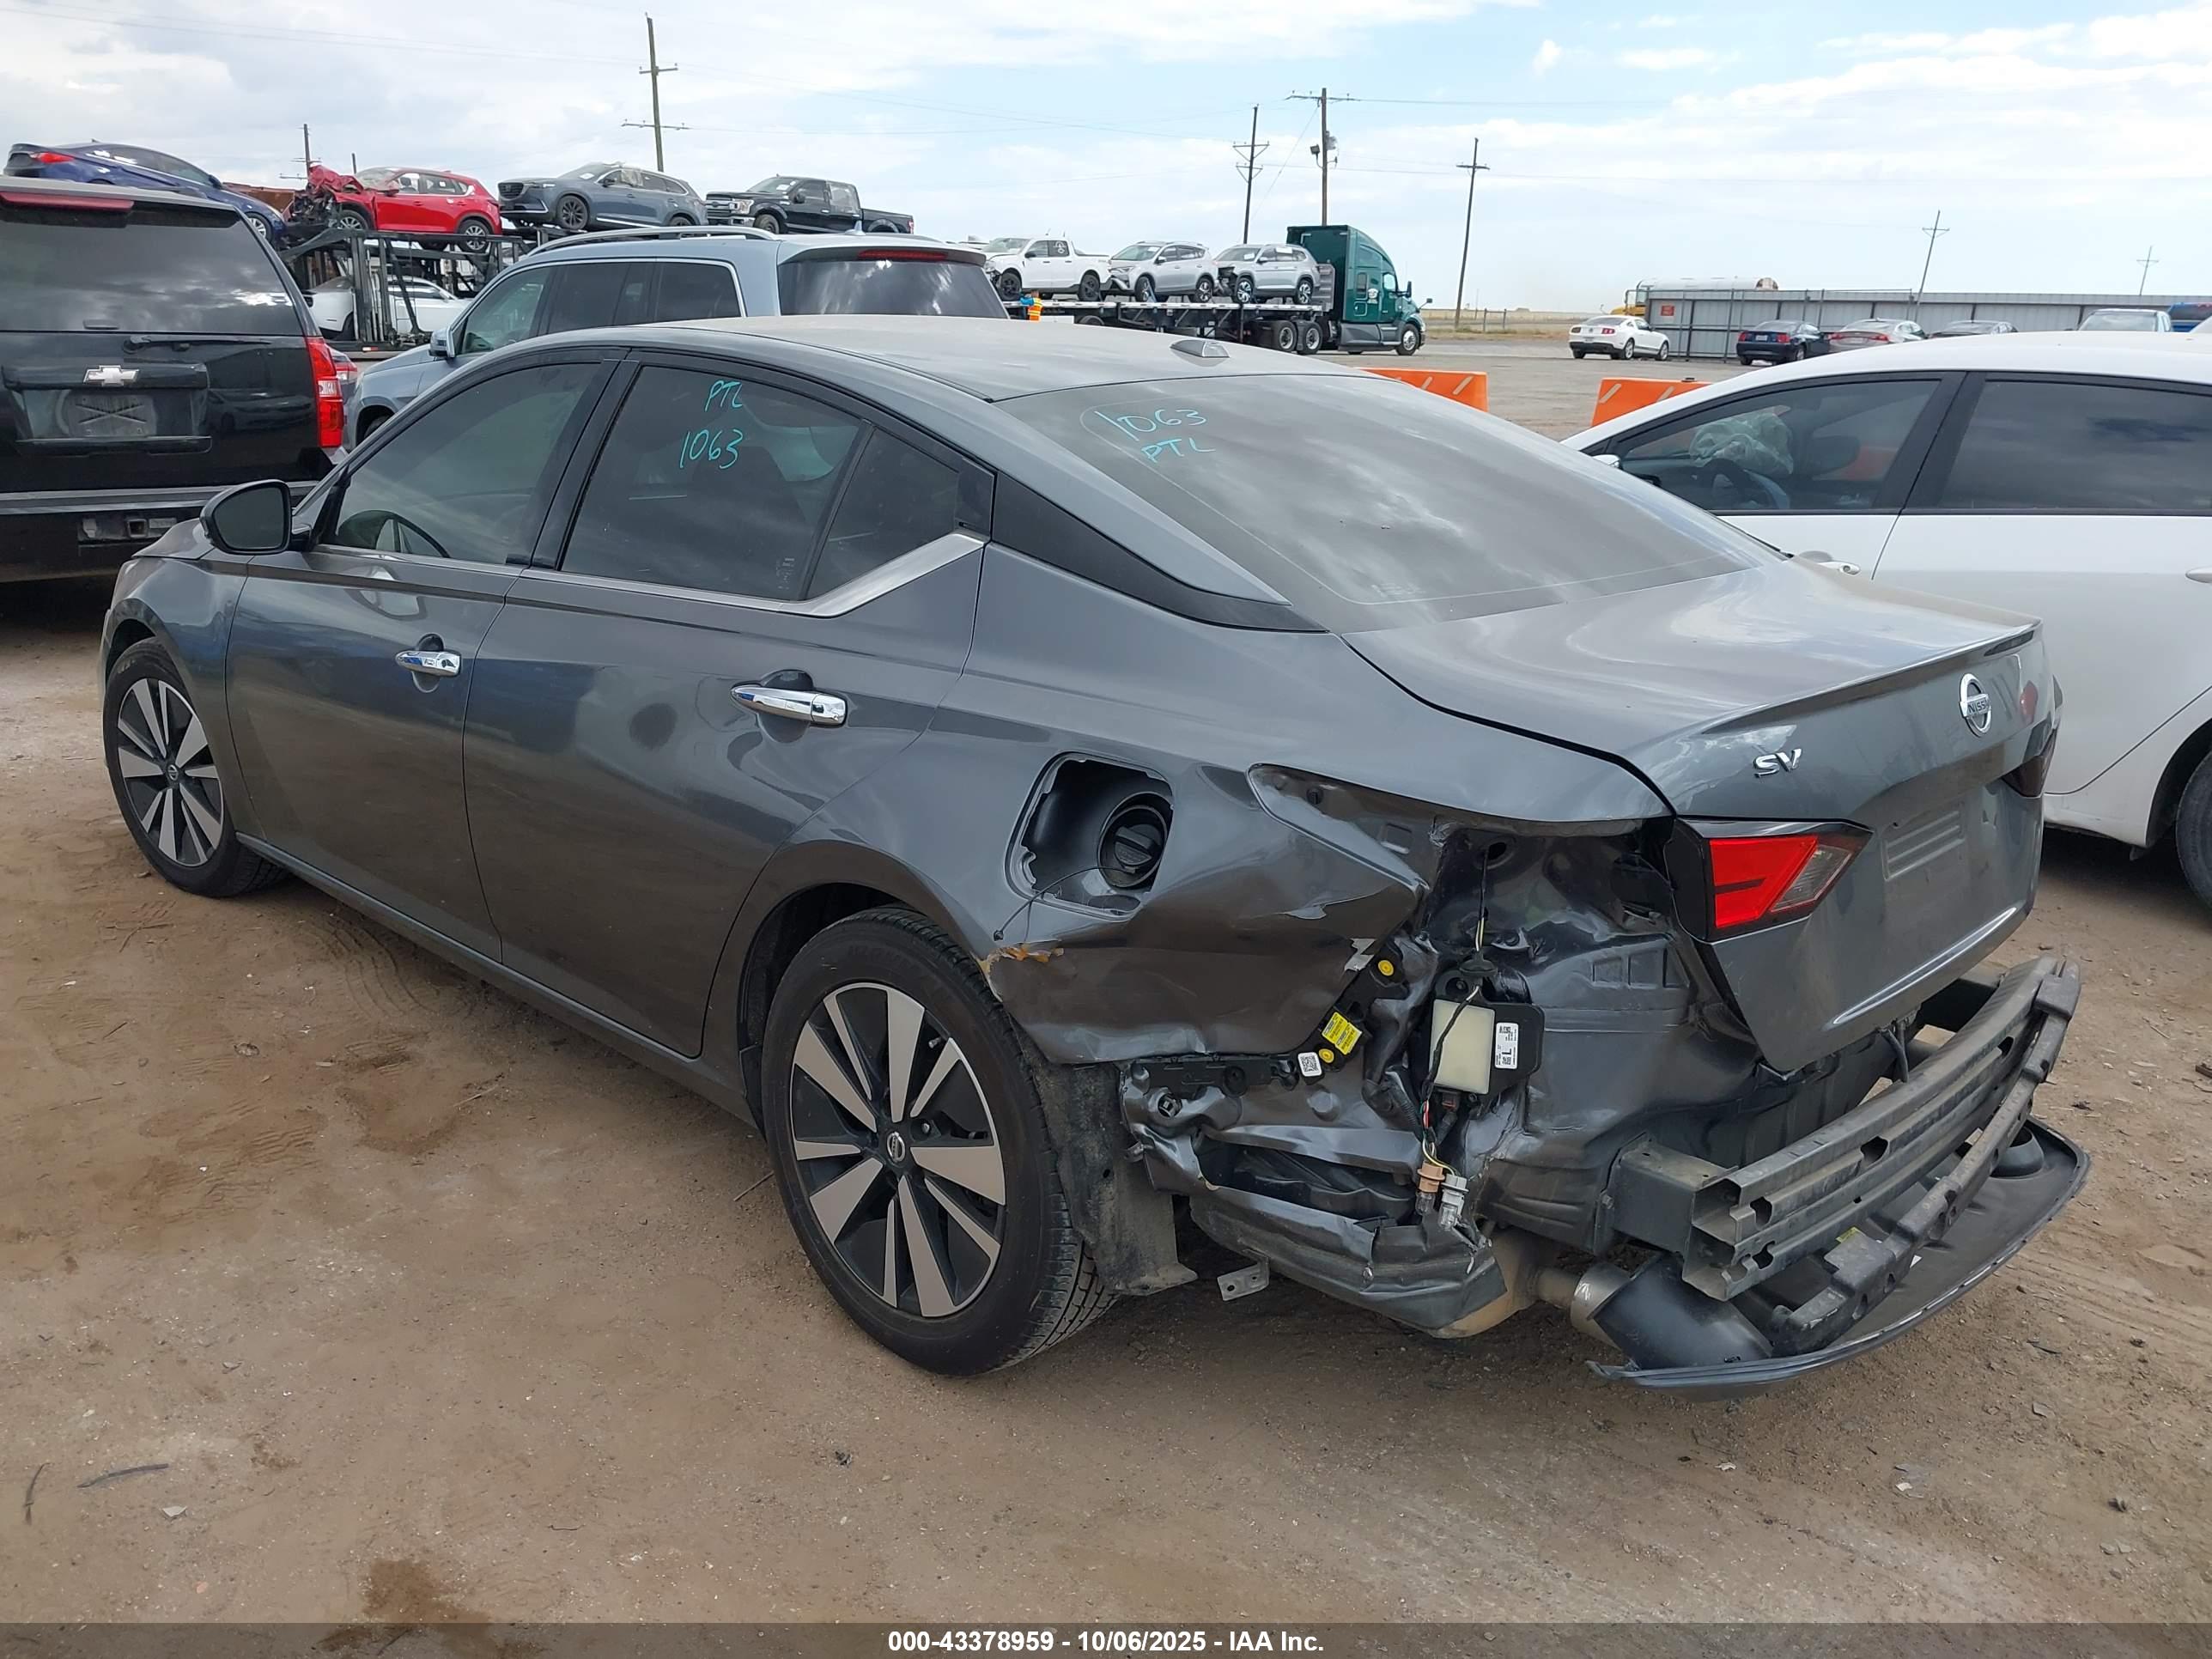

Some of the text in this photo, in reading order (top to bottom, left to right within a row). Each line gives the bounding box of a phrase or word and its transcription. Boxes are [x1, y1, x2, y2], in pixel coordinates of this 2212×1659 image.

[705, 380, 743, 412] PTL
[1094, 409, 1207, 442] 1063
[679, 428, 744, 470] 1063
[1140, 438, 1217, 464] PTL
[1753, 748, 1802, 778] SV
